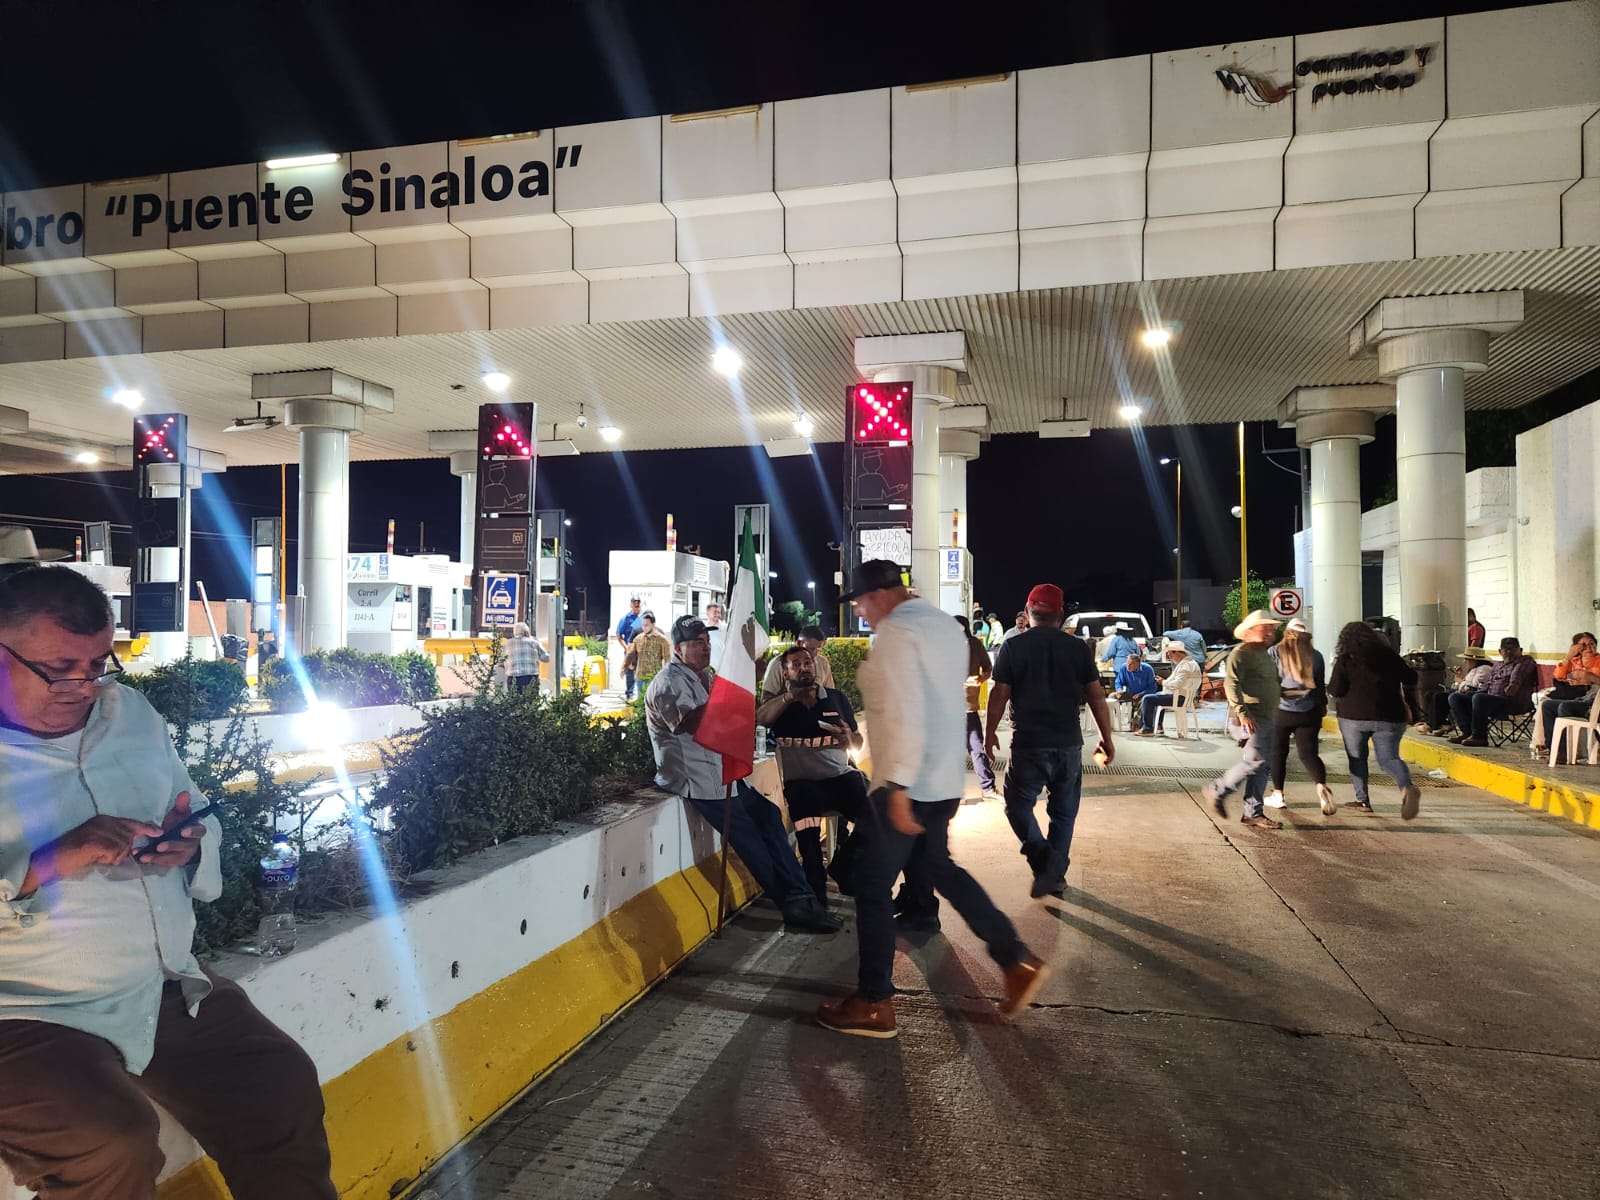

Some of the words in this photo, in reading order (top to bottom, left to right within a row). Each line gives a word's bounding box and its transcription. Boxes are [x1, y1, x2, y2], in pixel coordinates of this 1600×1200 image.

[0, 207, 83, 250] bro
[864, 530, 902, 542] AYUDA
[357, 588, 379, 597] Carril
[1281, 594, 1293, 610] E
